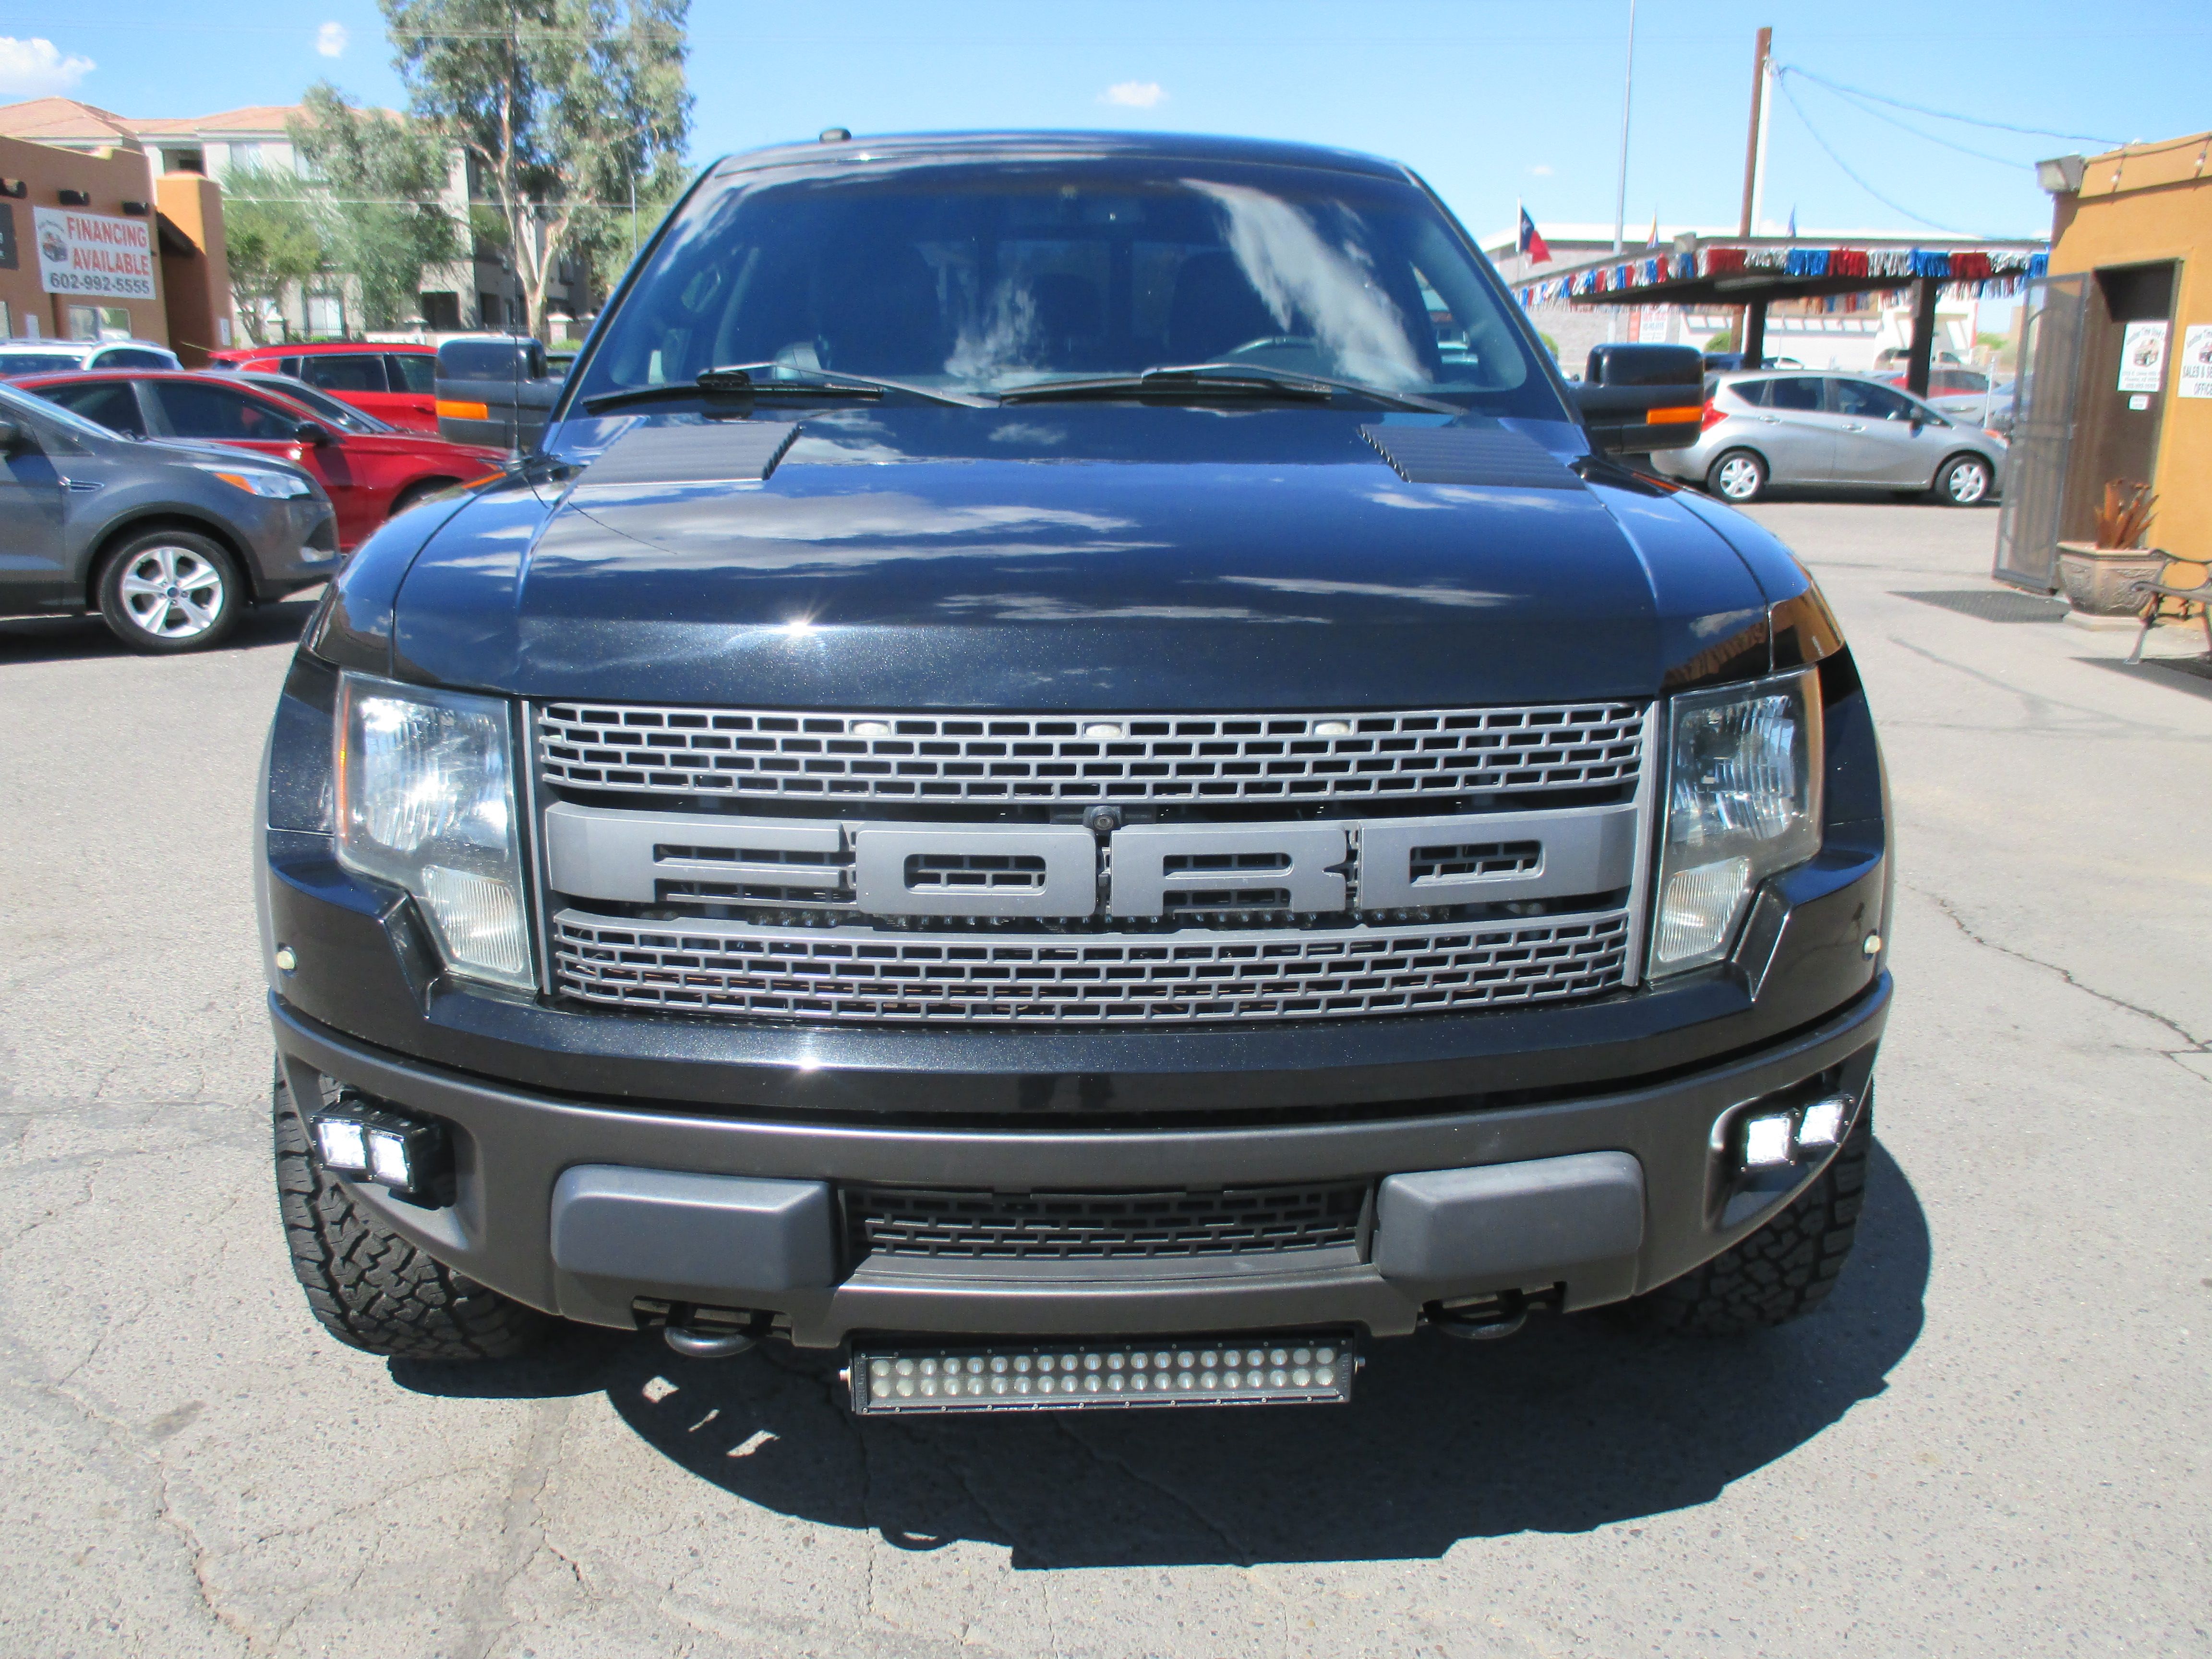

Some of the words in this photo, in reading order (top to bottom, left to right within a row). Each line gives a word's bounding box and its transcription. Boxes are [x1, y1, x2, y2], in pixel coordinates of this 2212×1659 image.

[66, 216, 147, 248] FINANCING
[73, 248, 150, 276] AVAILABLE
[50, 272, 150, 294] 602-992-5555
[546, 802, 1637, 920] FORD
